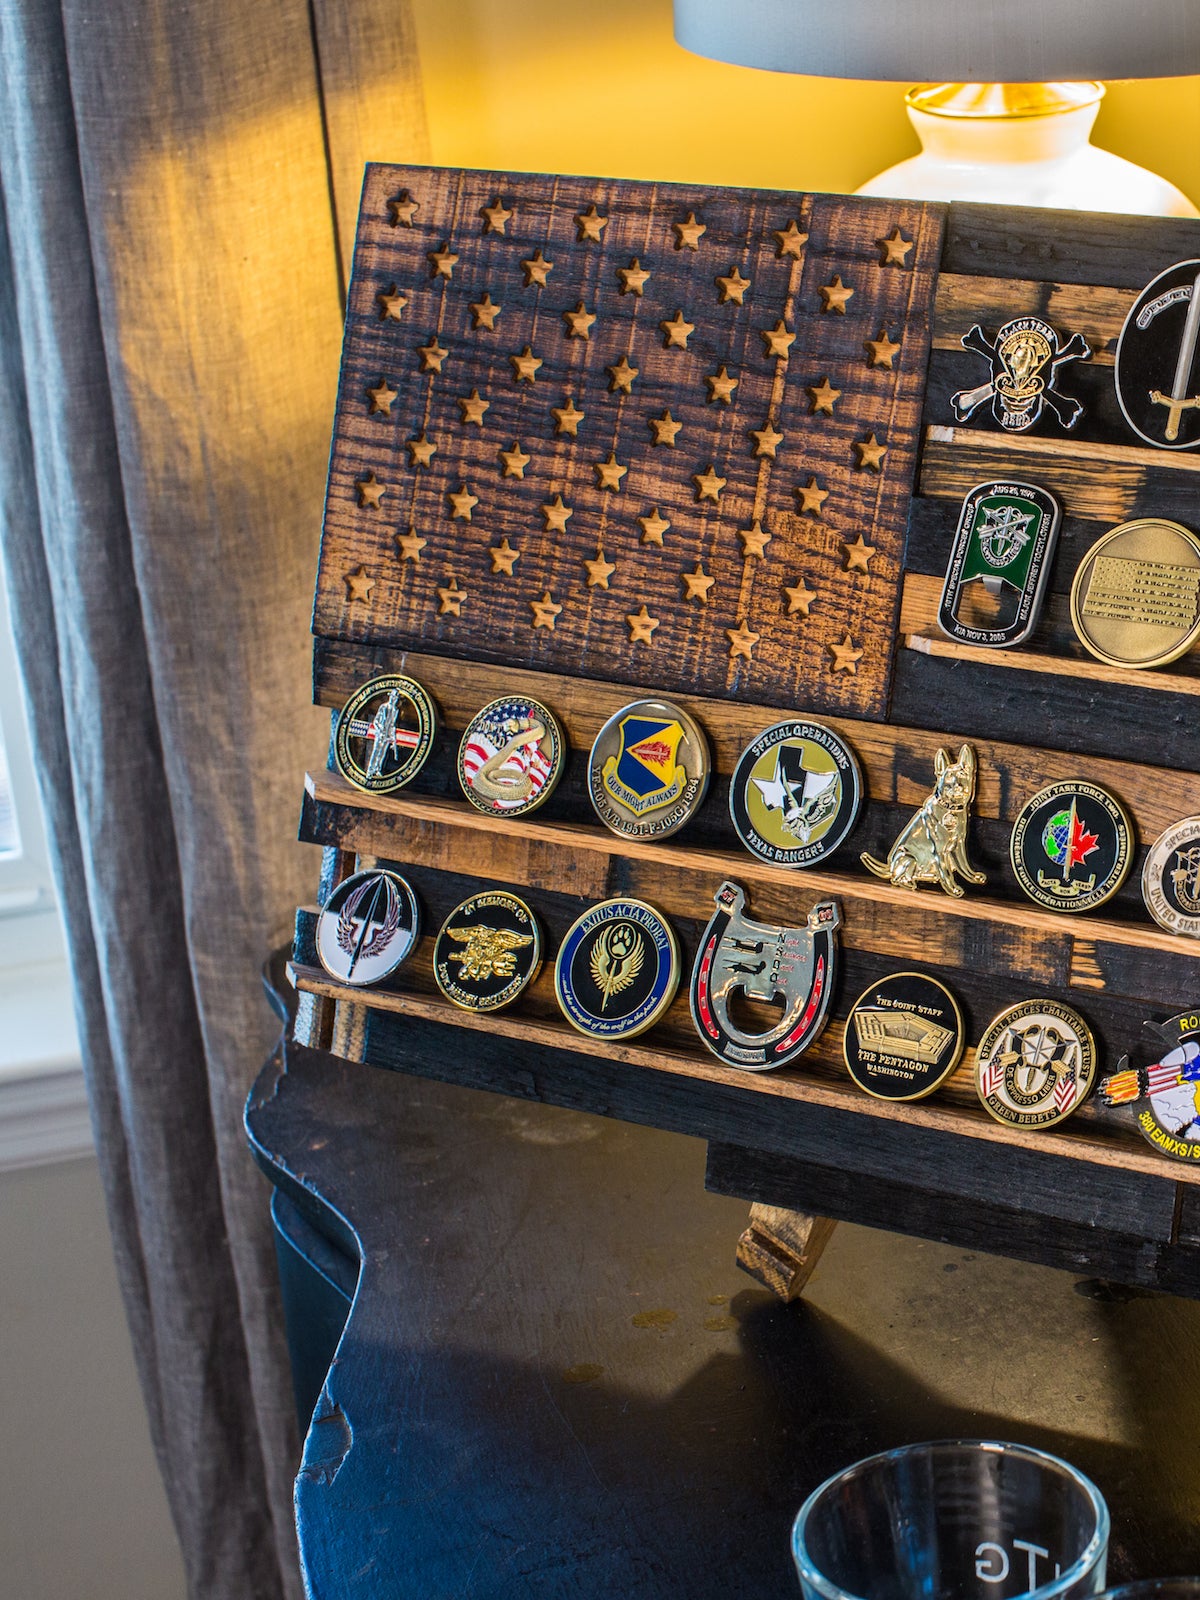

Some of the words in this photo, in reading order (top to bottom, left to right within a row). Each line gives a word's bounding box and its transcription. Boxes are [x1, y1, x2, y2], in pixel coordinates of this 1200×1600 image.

[1031, 320, 1054, 342] TEAM
[1020, 595, 1032, 621] MAJOR
[1027, 563, 1039, 595] JEFFREY
[954, 624, 966, 637] KIA
[752, 727, 792, 757] SPECIAL
[793, 725, 849, 770] OPERATIONS
[603, 808, 621, 826] A/B
[682, 777, 699, 808] 1984
[607, 775, 622, 795] OUR
[622, 792, 644, 812] MIGHT
[646, 784, 678, 807] ALWAYS
[1030, 791, 1052, 811] JOINT
[1053, 784, 1076, 794] TASK
[1078, 786, 1103, 802] FORCE
[746, 829, 774, 857] TEXAS
[774, 841, 824, 862] RANGERS
[1018, 865, 1037, 893] FORCE
[464, 903, 476, 915] IN
[477, 896, 518, 910] MEMORY
[1151, 887, 1176, 922] UNITED
[580, 905, 613, 933] EXITUS
[614, 904, 640, 920] ACTA
[640, 909, 669, 951] PROBAT
[876, 997, 891, 1007] THE
[892, 1000, 917, 1012] JOINT
[917, 1005, 943, 1016] STAFF
[591, 1019, 600, 1030] of
[610, 1019, 626, 1031] wolf
[982, 1023, 1007, 1059] SPECIAL
[1007, 1005, 1041, 1023] FORCES
[1042, 1006, 1087, 1044] CHARITABLE
[1081, 1044, 1091, 1078] TRUST
[858, 1049, 877, 1062] THE
[879, 1054, 929, 1073] PENTAGON
[866, 1063, 915, 1080] WASHINGTON
[1007, 1066, 1014, 1078] DE
[1006, 1080, 1039, 1105] OPPRESSO
[1039, 1075, 1056, 1097] LIBER
[988, 1096, 1017, 1121] GREEN
[1018, 1109, 1056, 1124] BERETS
[1138, 1111, 1155, 1132] 380
